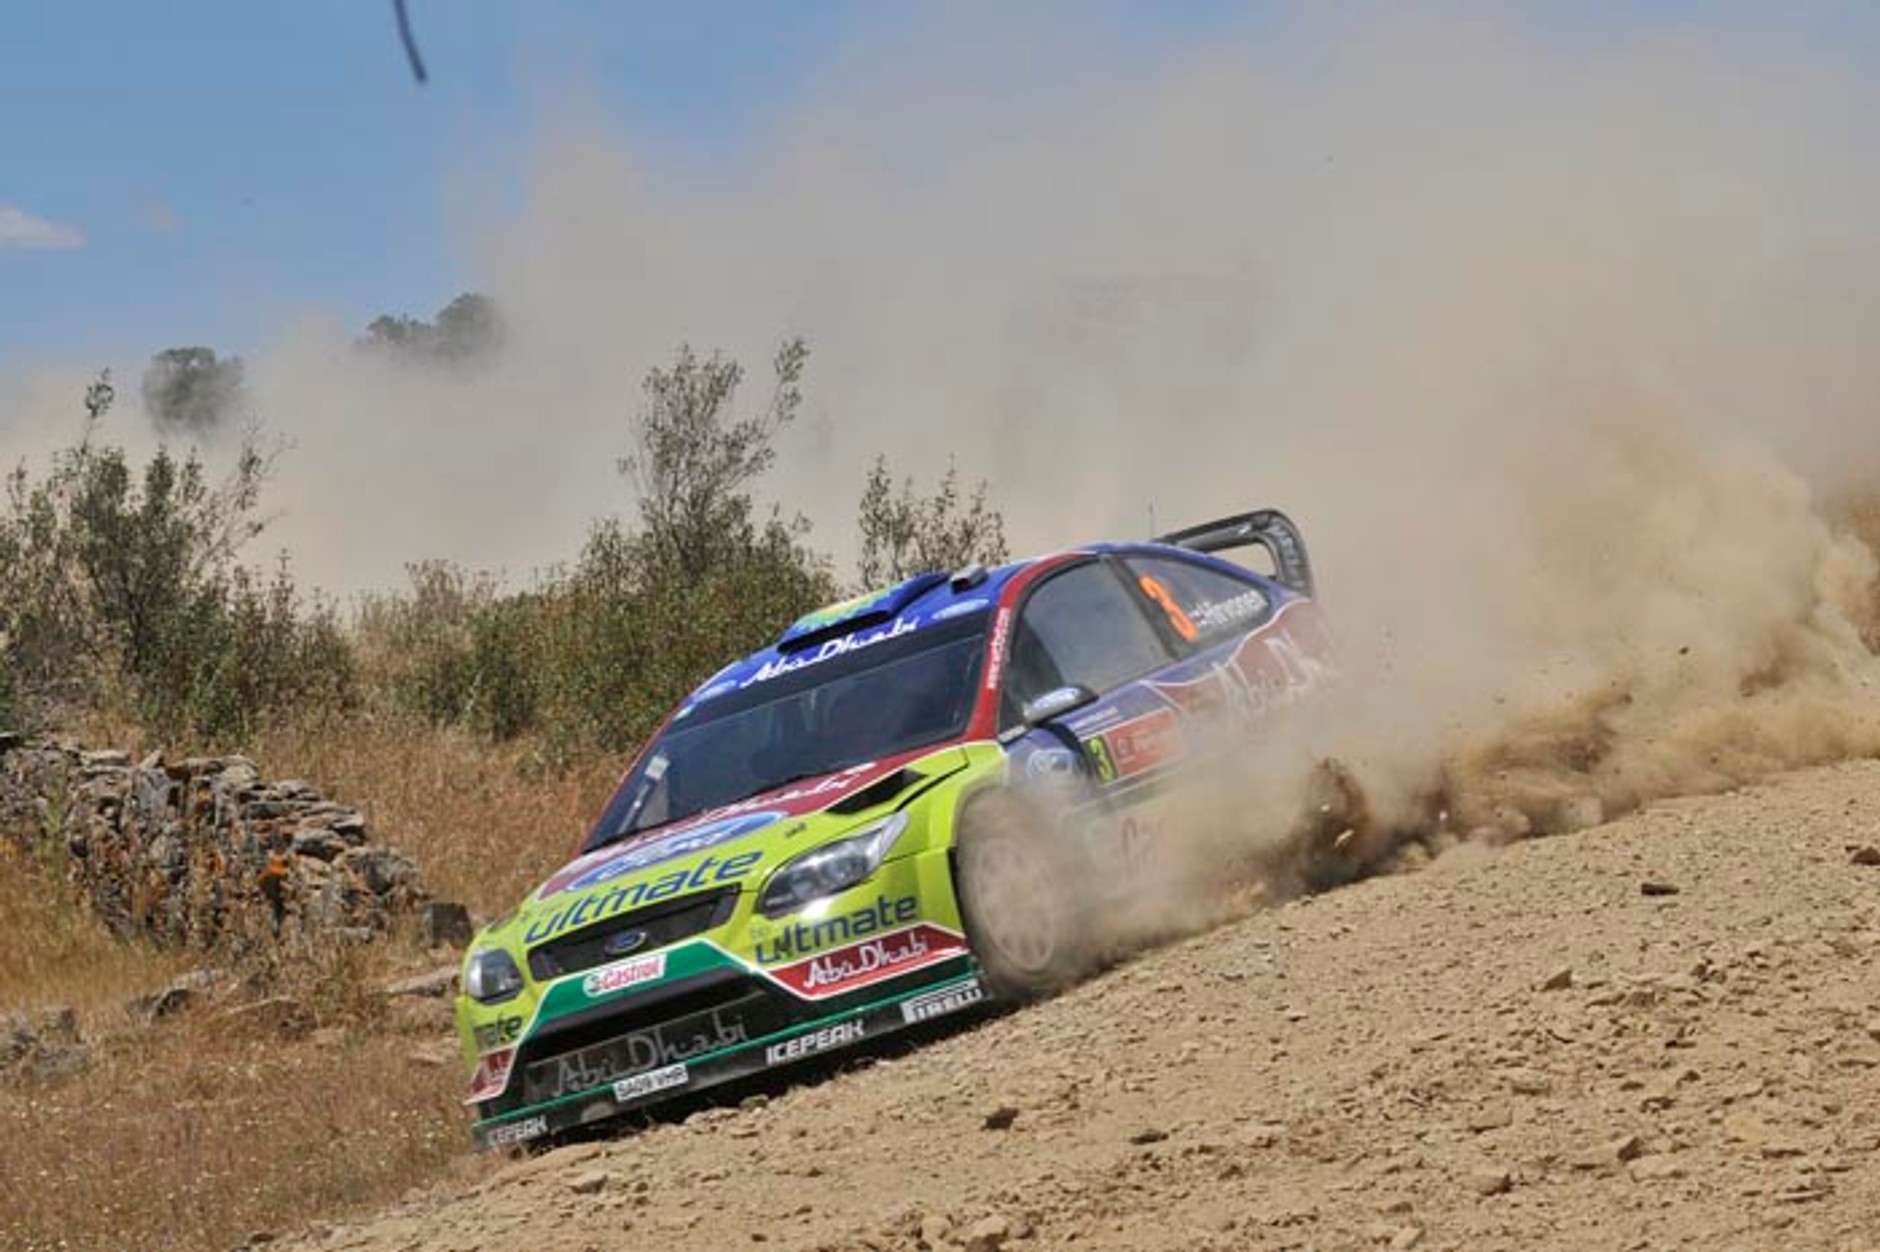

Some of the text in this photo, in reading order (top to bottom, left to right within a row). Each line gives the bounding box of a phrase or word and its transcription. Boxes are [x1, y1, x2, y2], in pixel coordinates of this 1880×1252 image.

[1139, 574, 1197, 642] 3
[740, 616, 920, 688] Abu Dhabi
[1088, 737, 1116, 782] 3
[803, 930, 928, 989] Abu Dhabi
[766, 1018, 865, 1067] ICEPEAK
